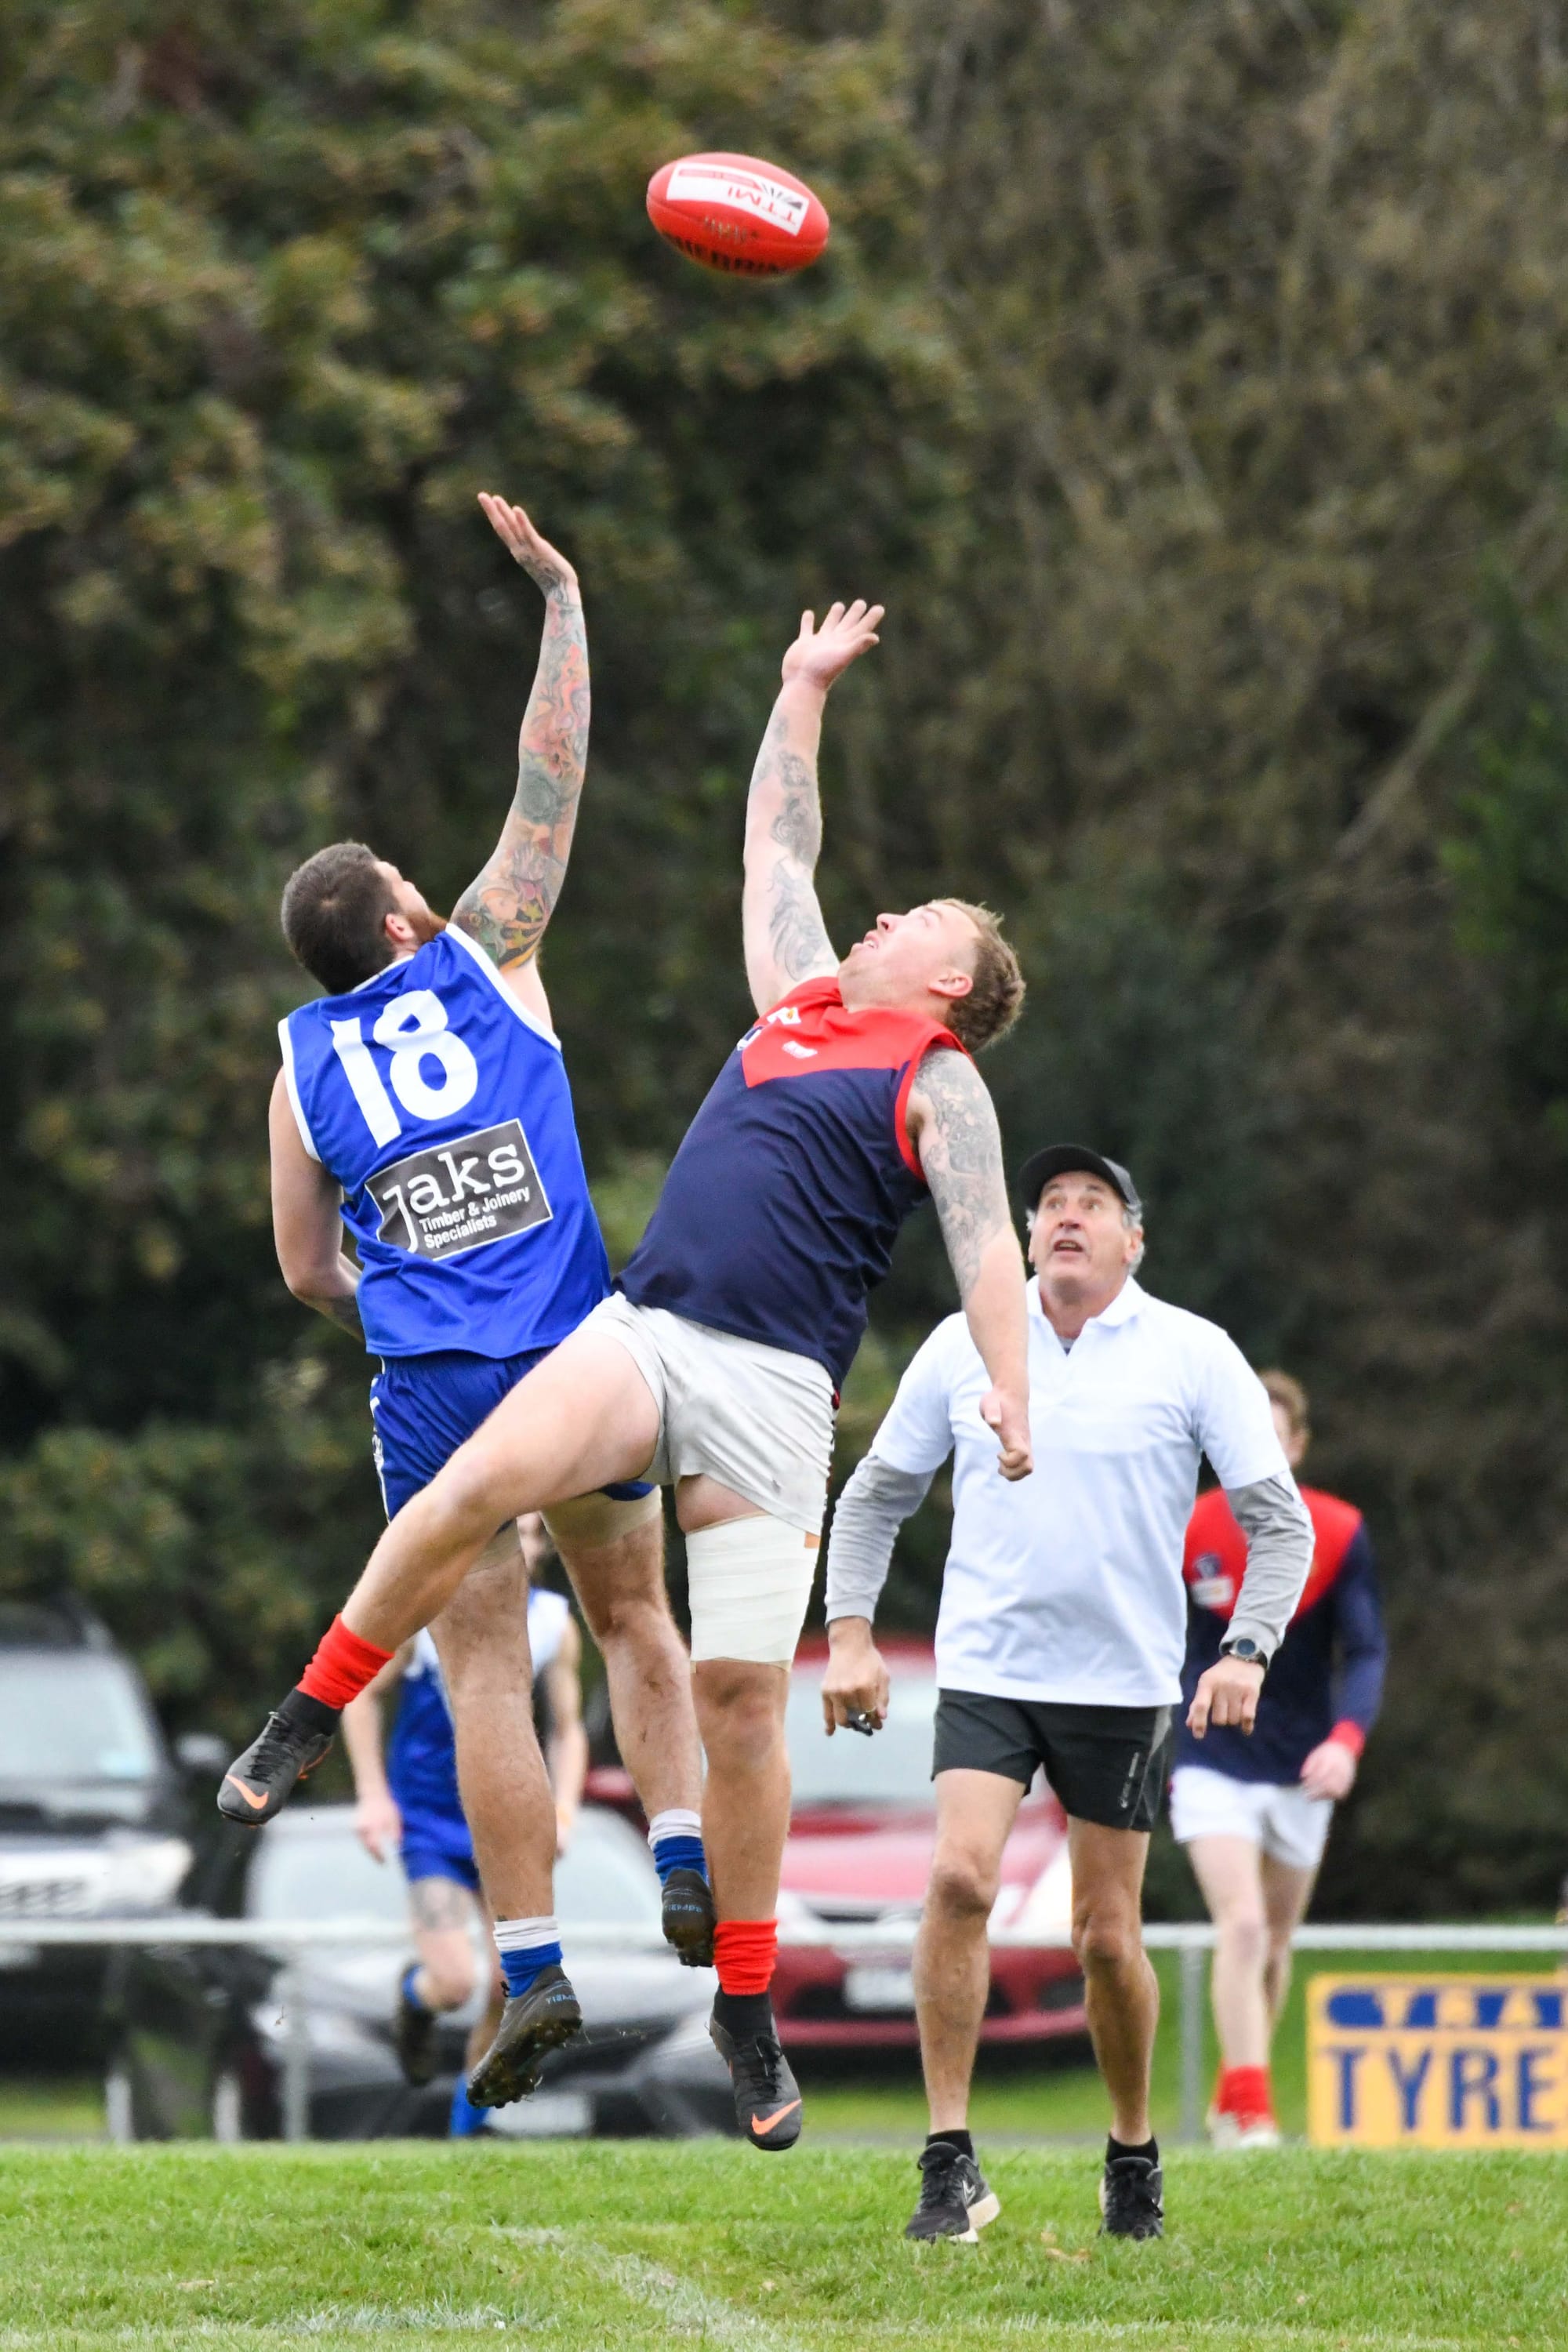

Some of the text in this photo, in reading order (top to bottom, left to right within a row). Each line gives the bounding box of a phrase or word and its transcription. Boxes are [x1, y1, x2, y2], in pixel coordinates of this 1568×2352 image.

[331, 989, 478, 1149] 18
[419, 1186, 531, 1233] Timber & Joinery
[423, 1214, 497, 1249] Specialists
[1327, 2044, 1555, 2131] TYRE
